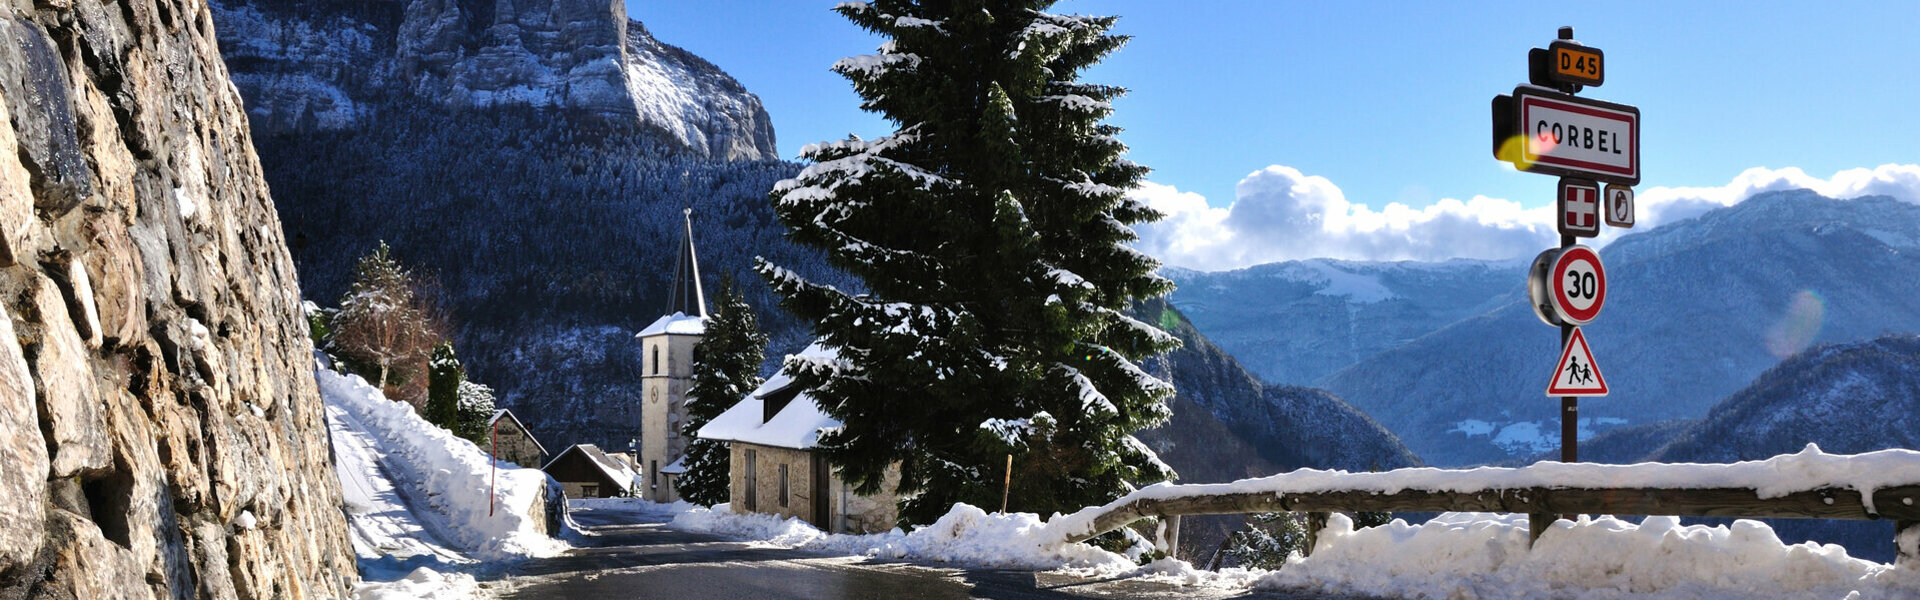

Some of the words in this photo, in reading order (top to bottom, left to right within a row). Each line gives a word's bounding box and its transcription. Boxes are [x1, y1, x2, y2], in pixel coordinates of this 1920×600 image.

[1561, 52, 1571, 70] D
[1575, 55, 1597, 75] 45
[1537, 120, 1622, 154] CORBEL
[1567, 270, 1596, 300] 30
